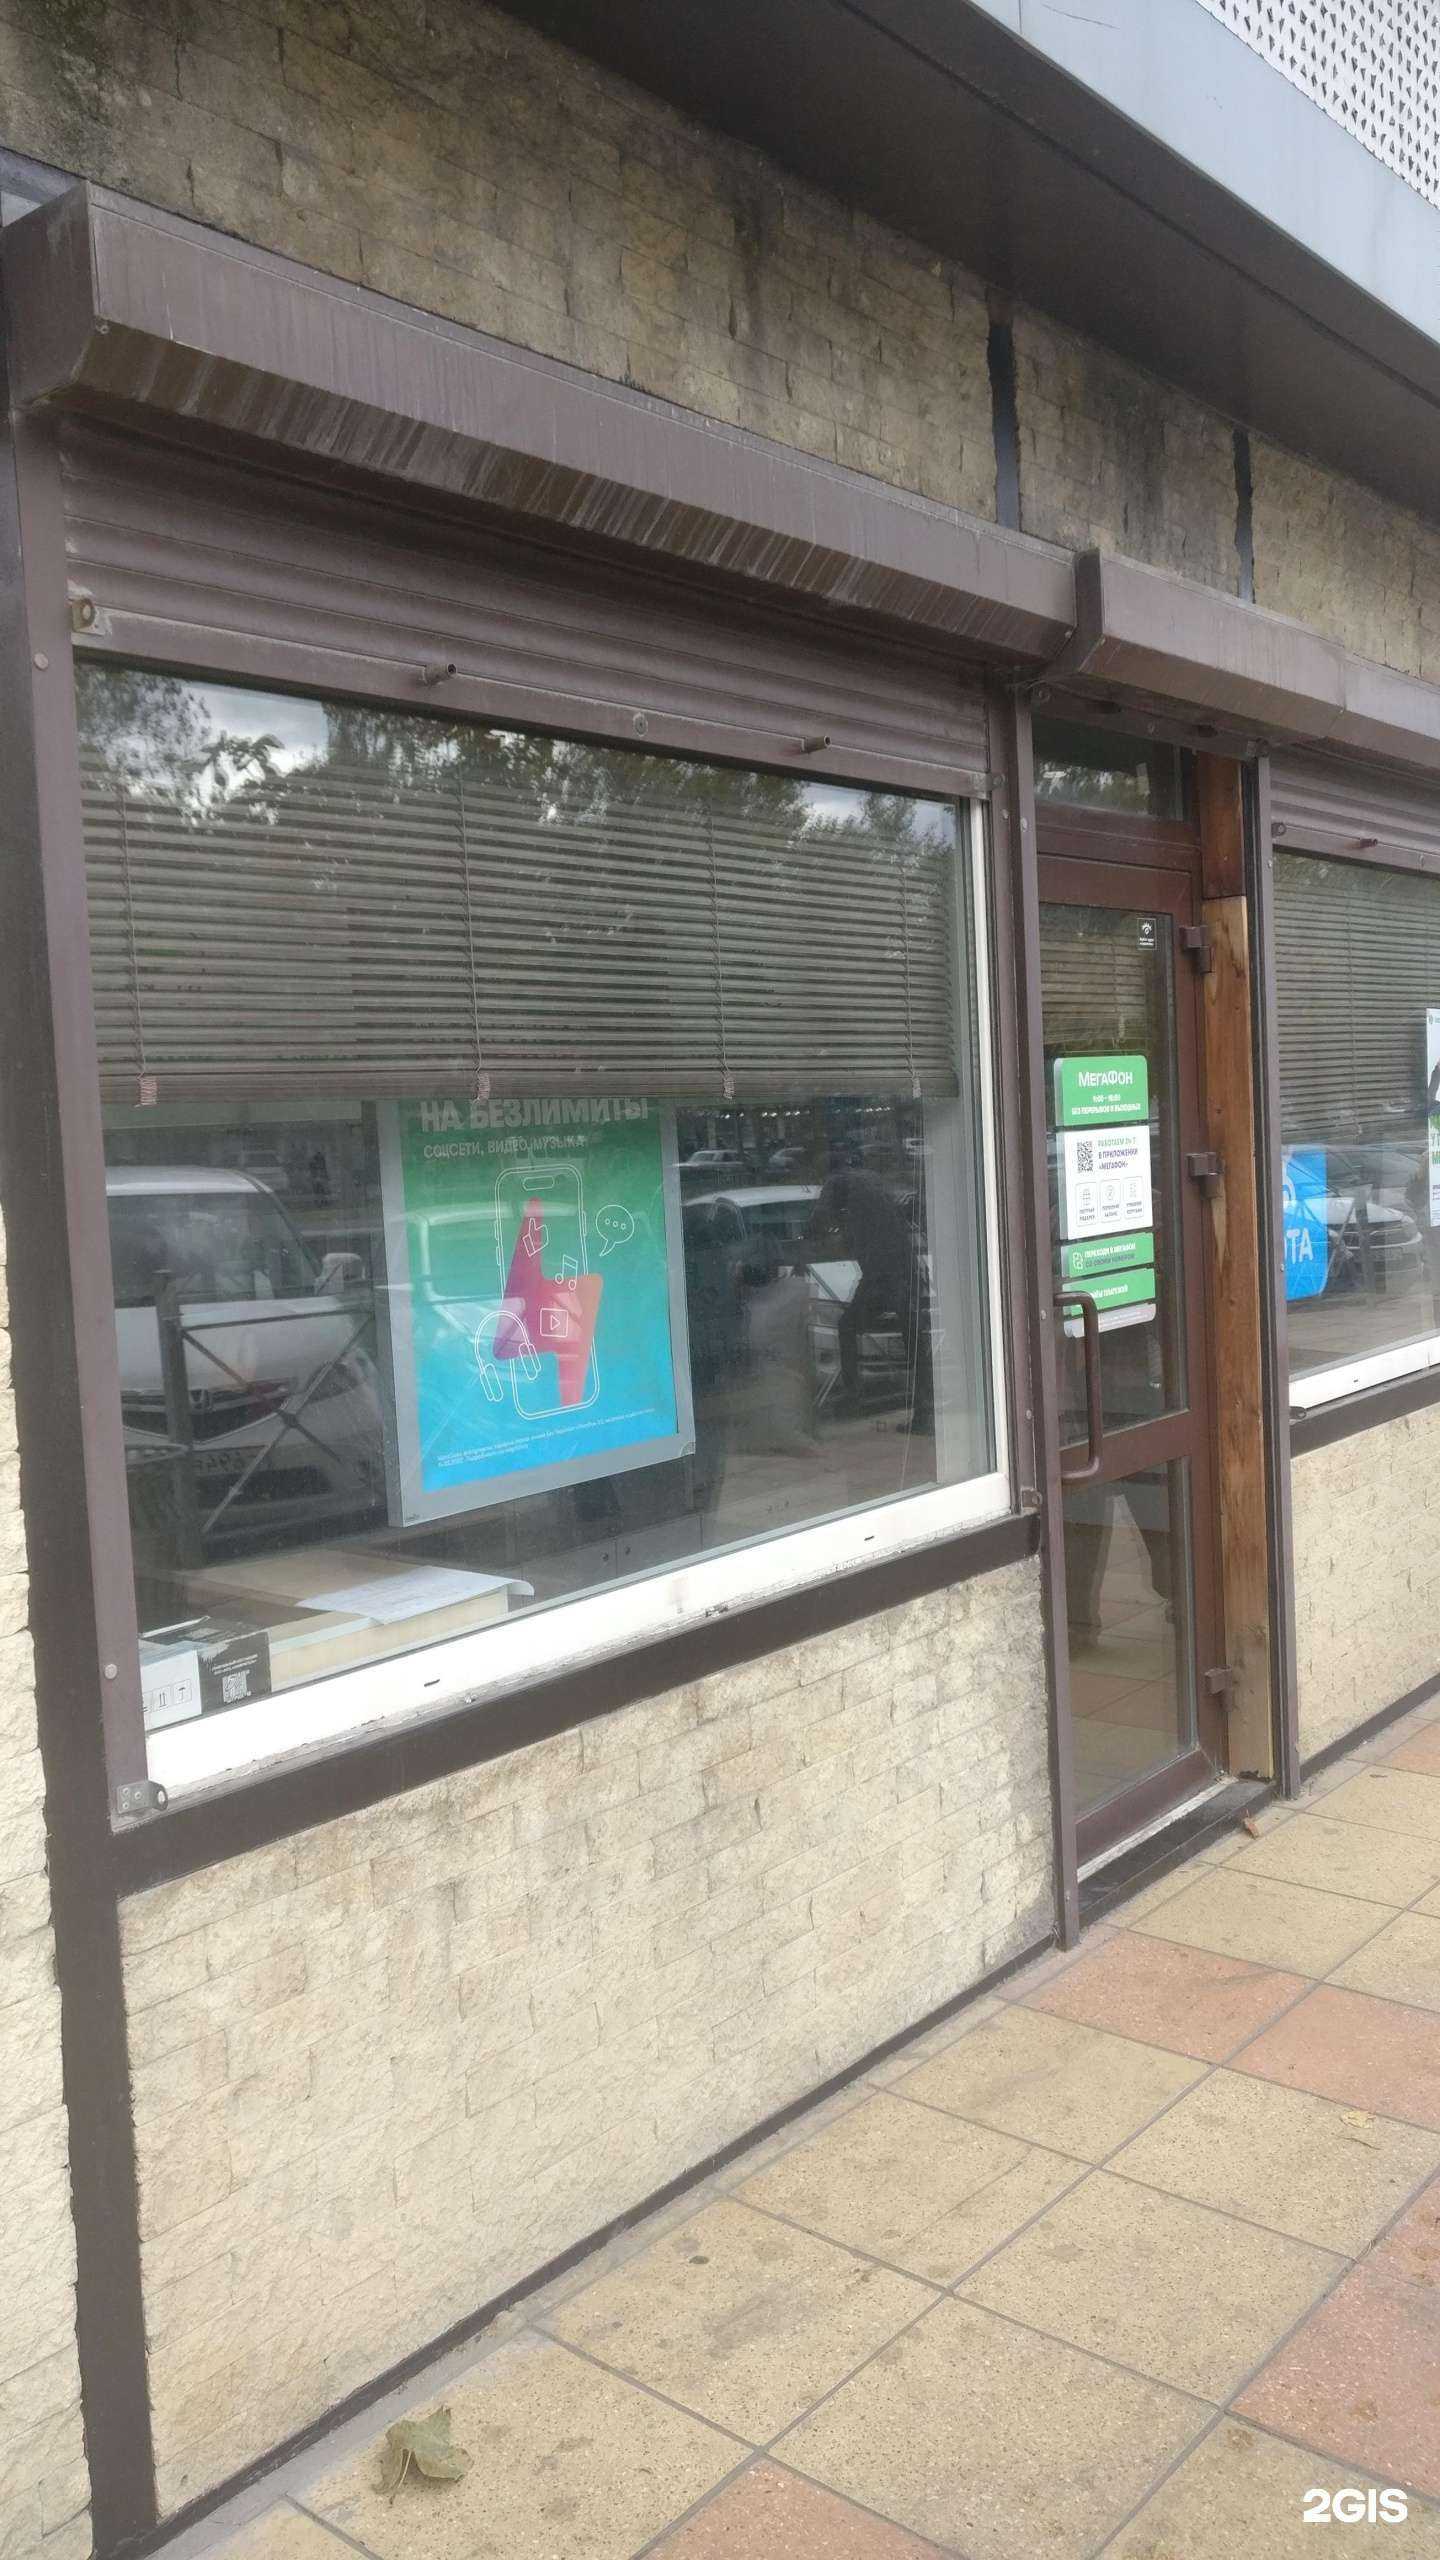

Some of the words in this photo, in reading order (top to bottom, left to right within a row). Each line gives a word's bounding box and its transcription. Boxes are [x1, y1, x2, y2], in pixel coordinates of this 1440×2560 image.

[420, 1101, 465, 1132] НА
[470, 1098, 649, 1130] БЕЗЛИМИТЫ
[423, 1142, 484, 1159] СОЦСЕТИ,
